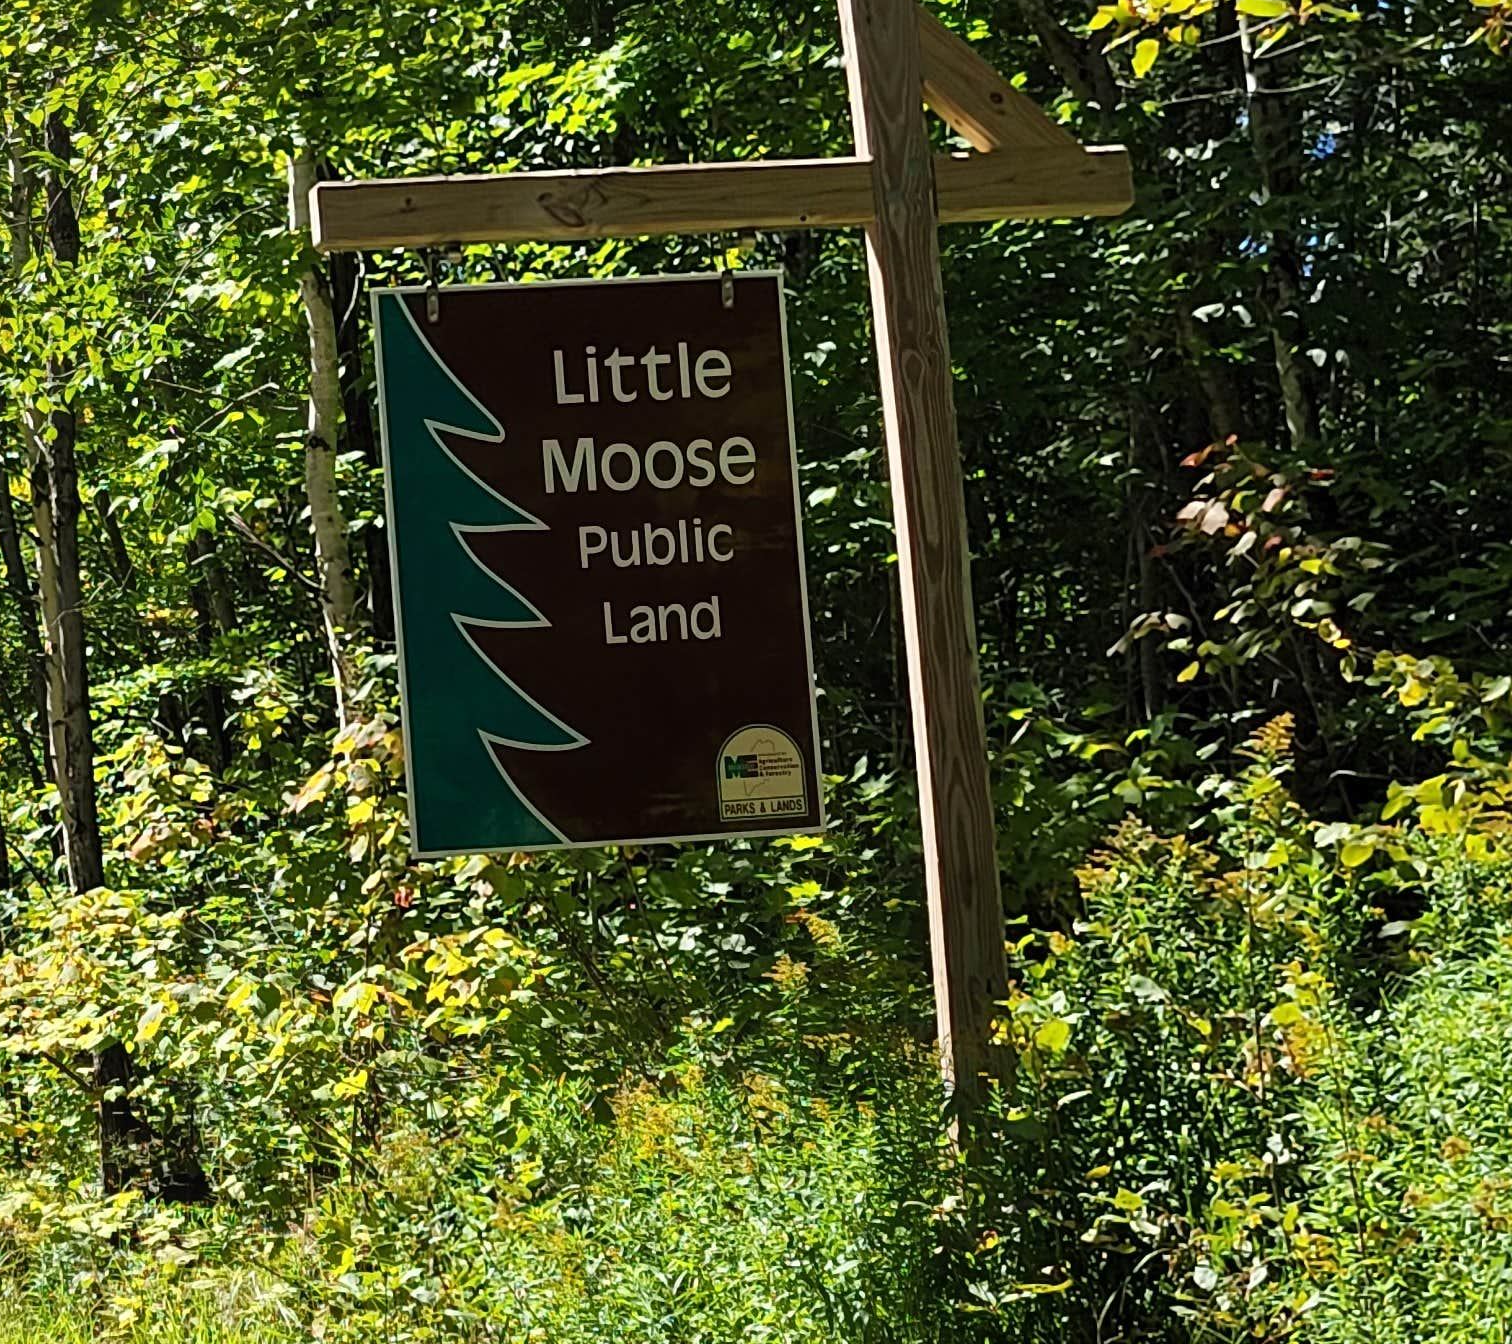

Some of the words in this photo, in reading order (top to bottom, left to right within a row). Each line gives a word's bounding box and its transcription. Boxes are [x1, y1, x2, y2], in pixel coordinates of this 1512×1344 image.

[553, 342, 732, 405] Little
[542, 435, 756, 494] Moose
[579, 518, 734, 568] Public
[603, 596, 721, 644] Land
[724, 802, 756, 816] PARKS
[759, 801, 767, 813] &
[770, 798, 803, 813] LANDS
